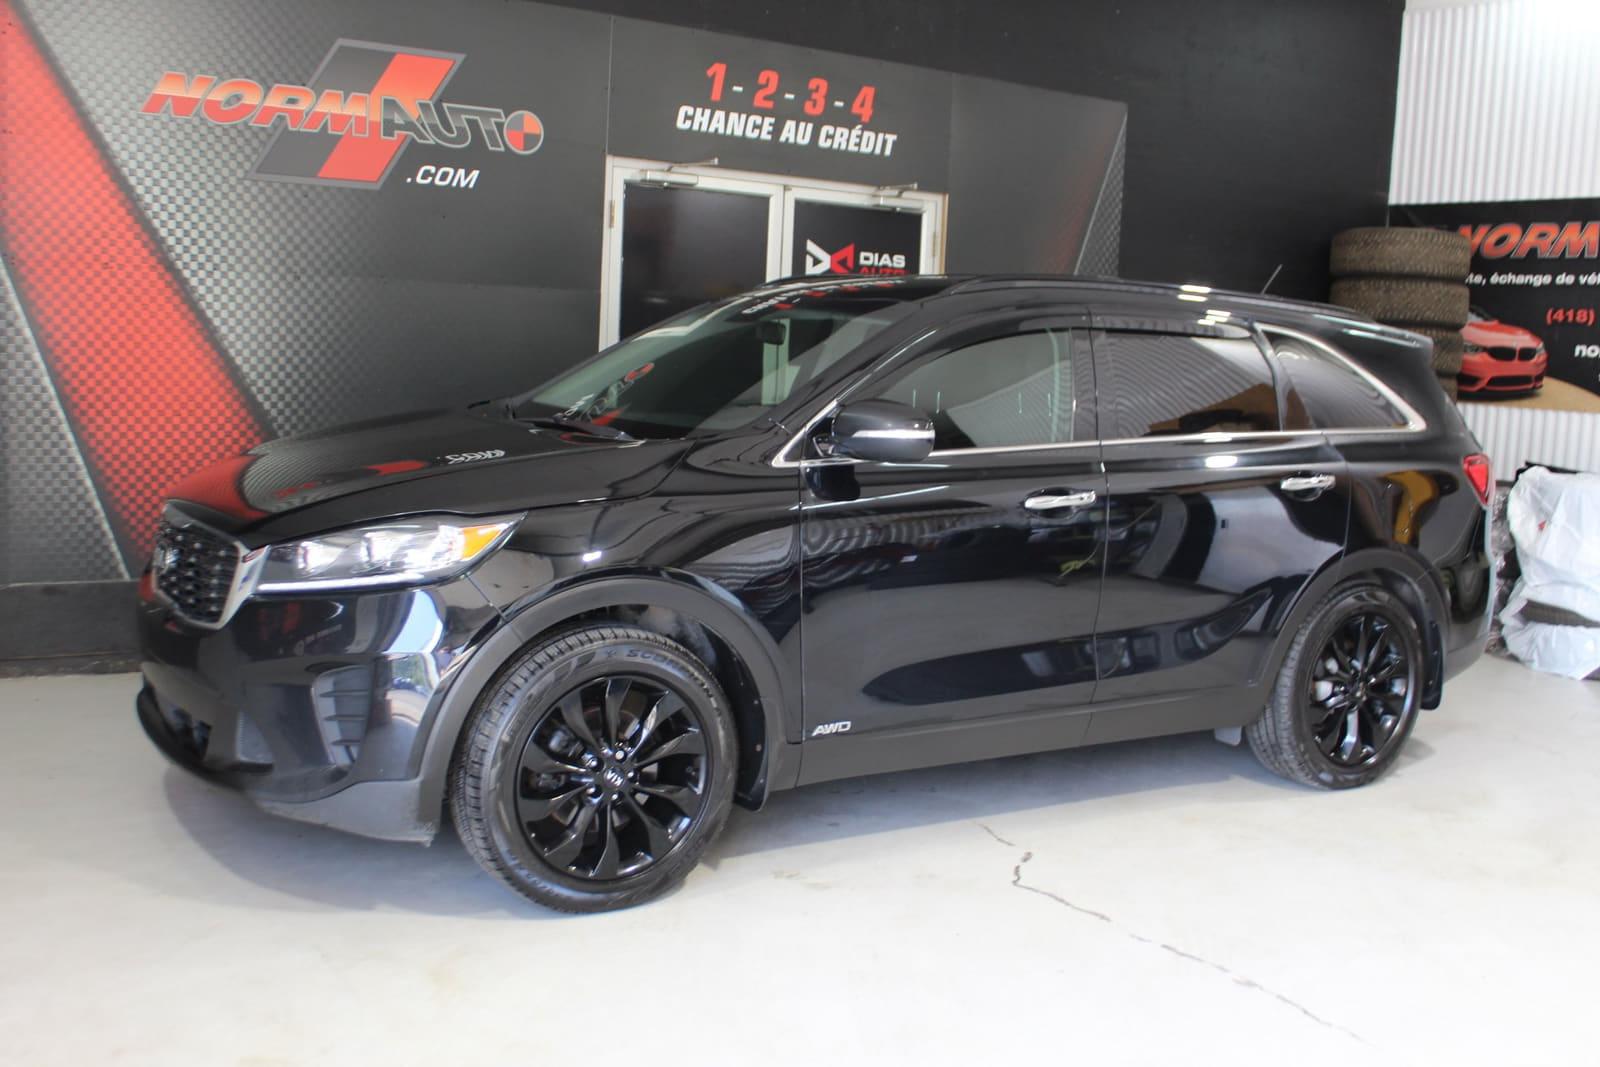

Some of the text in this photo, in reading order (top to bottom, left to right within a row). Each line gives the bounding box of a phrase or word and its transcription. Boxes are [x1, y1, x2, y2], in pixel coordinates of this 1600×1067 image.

[676, 105, 898, 156] CHANCE AU CRÉDIT
[406, 164, 480, 189] .COM
[859, 251, 906, 269] DIAS
[1489, 272, 1552, 287] échange
[1555, 272, 1576, 286] de
[1546, 307, 1596, 327] (418)
[1574, 344, 1600, 358] no
[811, 720, 852, 737] AWD
